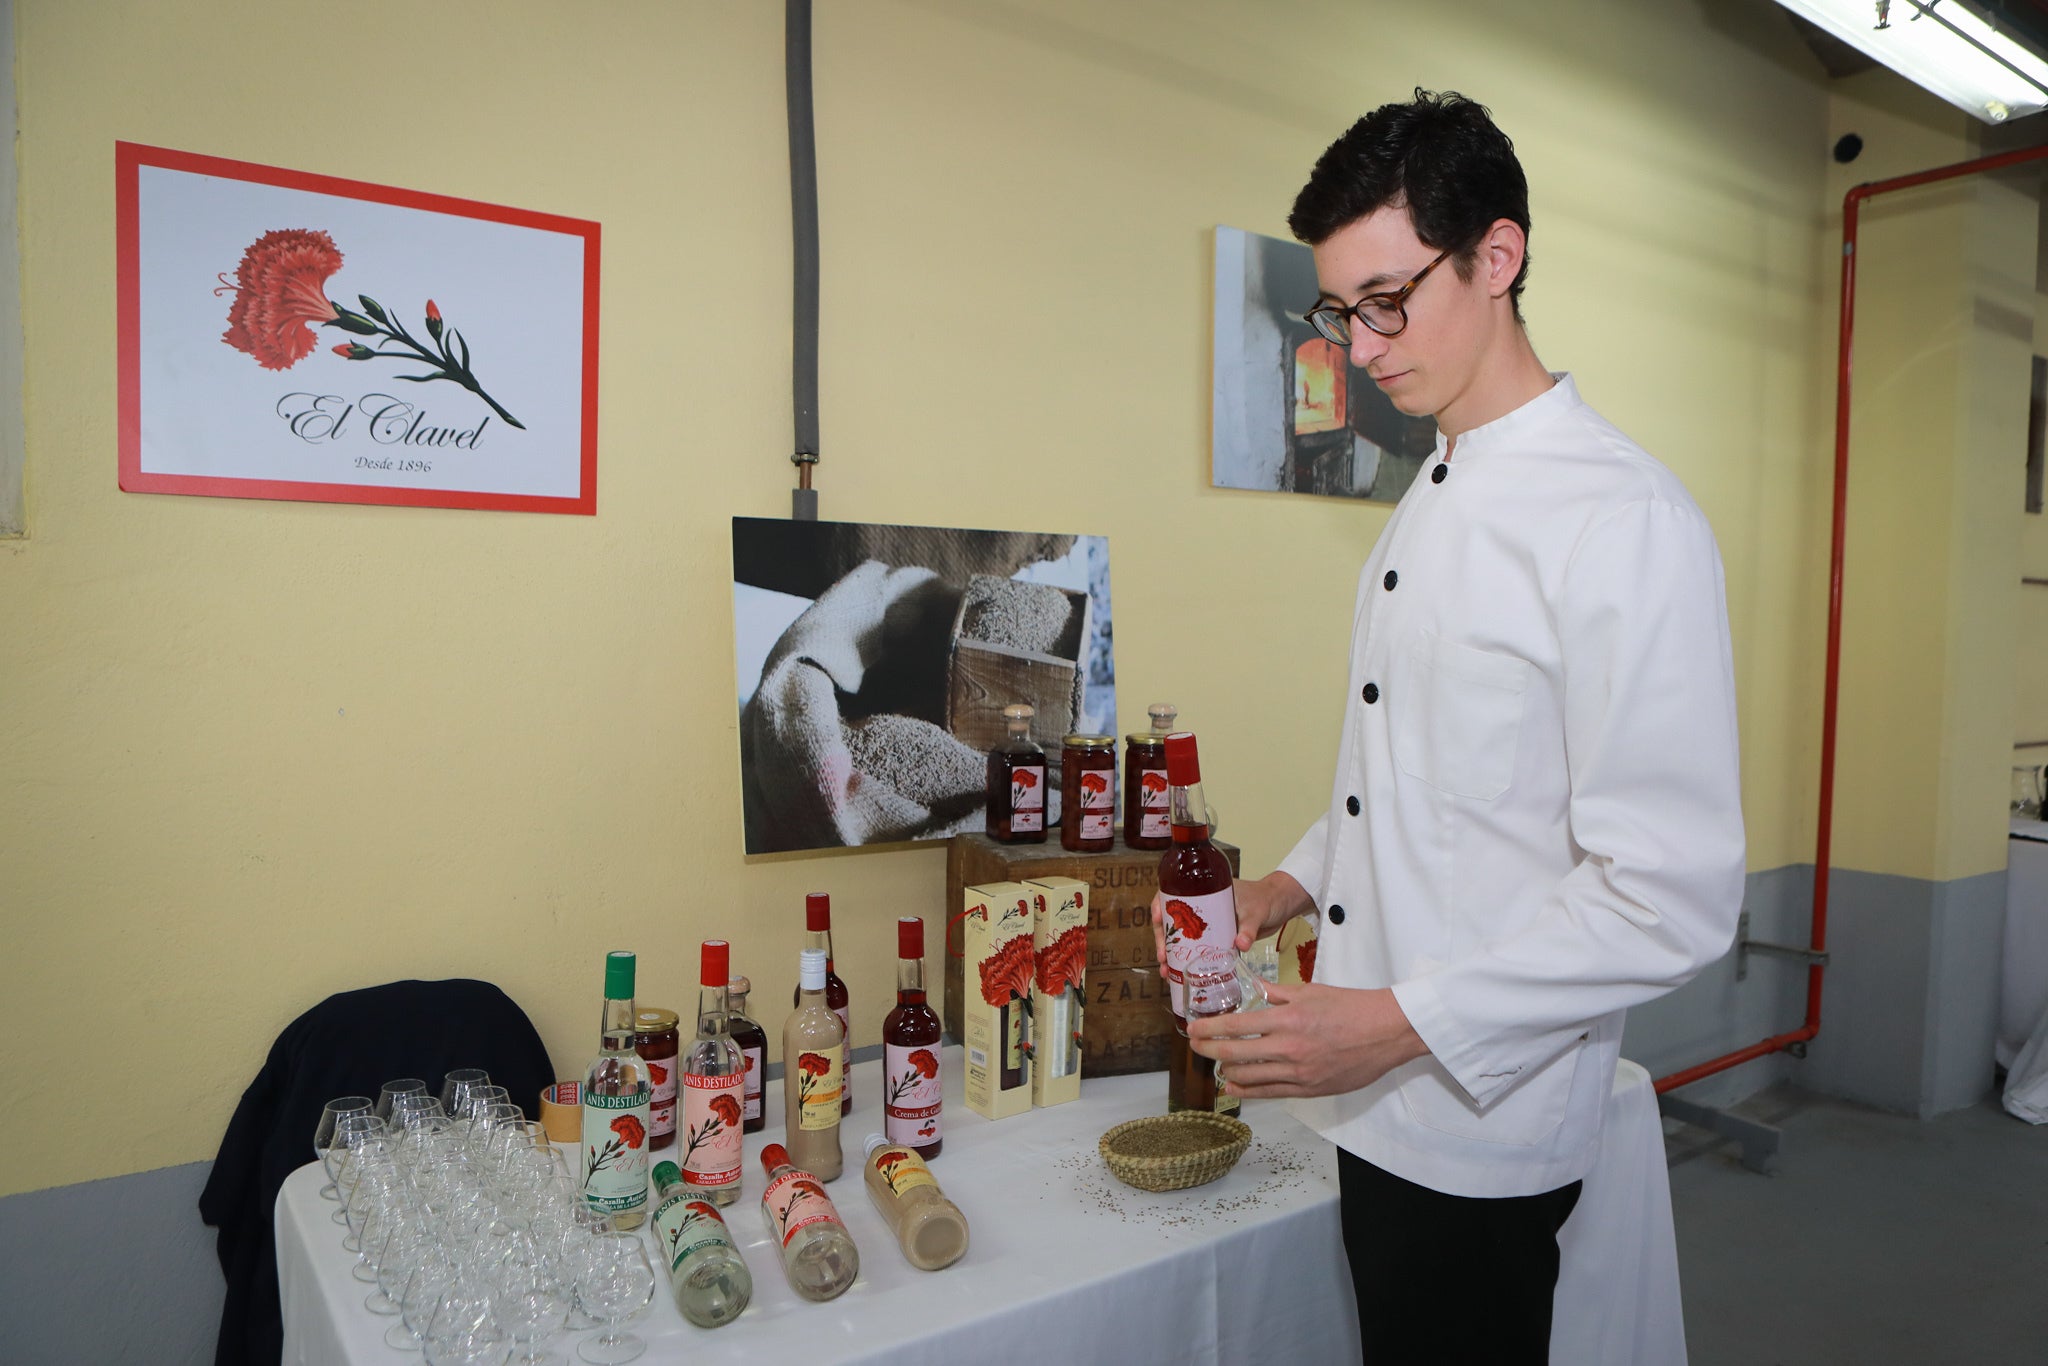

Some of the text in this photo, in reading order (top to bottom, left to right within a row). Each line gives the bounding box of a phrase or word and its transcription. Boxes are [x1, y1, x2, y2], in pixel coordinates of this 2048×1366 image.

[276, 392, 490, 450] El Clavel
[354, 456, 433, 473] Desde 1896
[683, 1075, 701, 1088] ANIS
[586, 1093, 606, 1107] ANIS
[894, 1109, 919, 1118] Crema
[920, 1109, 929, 1117] de
